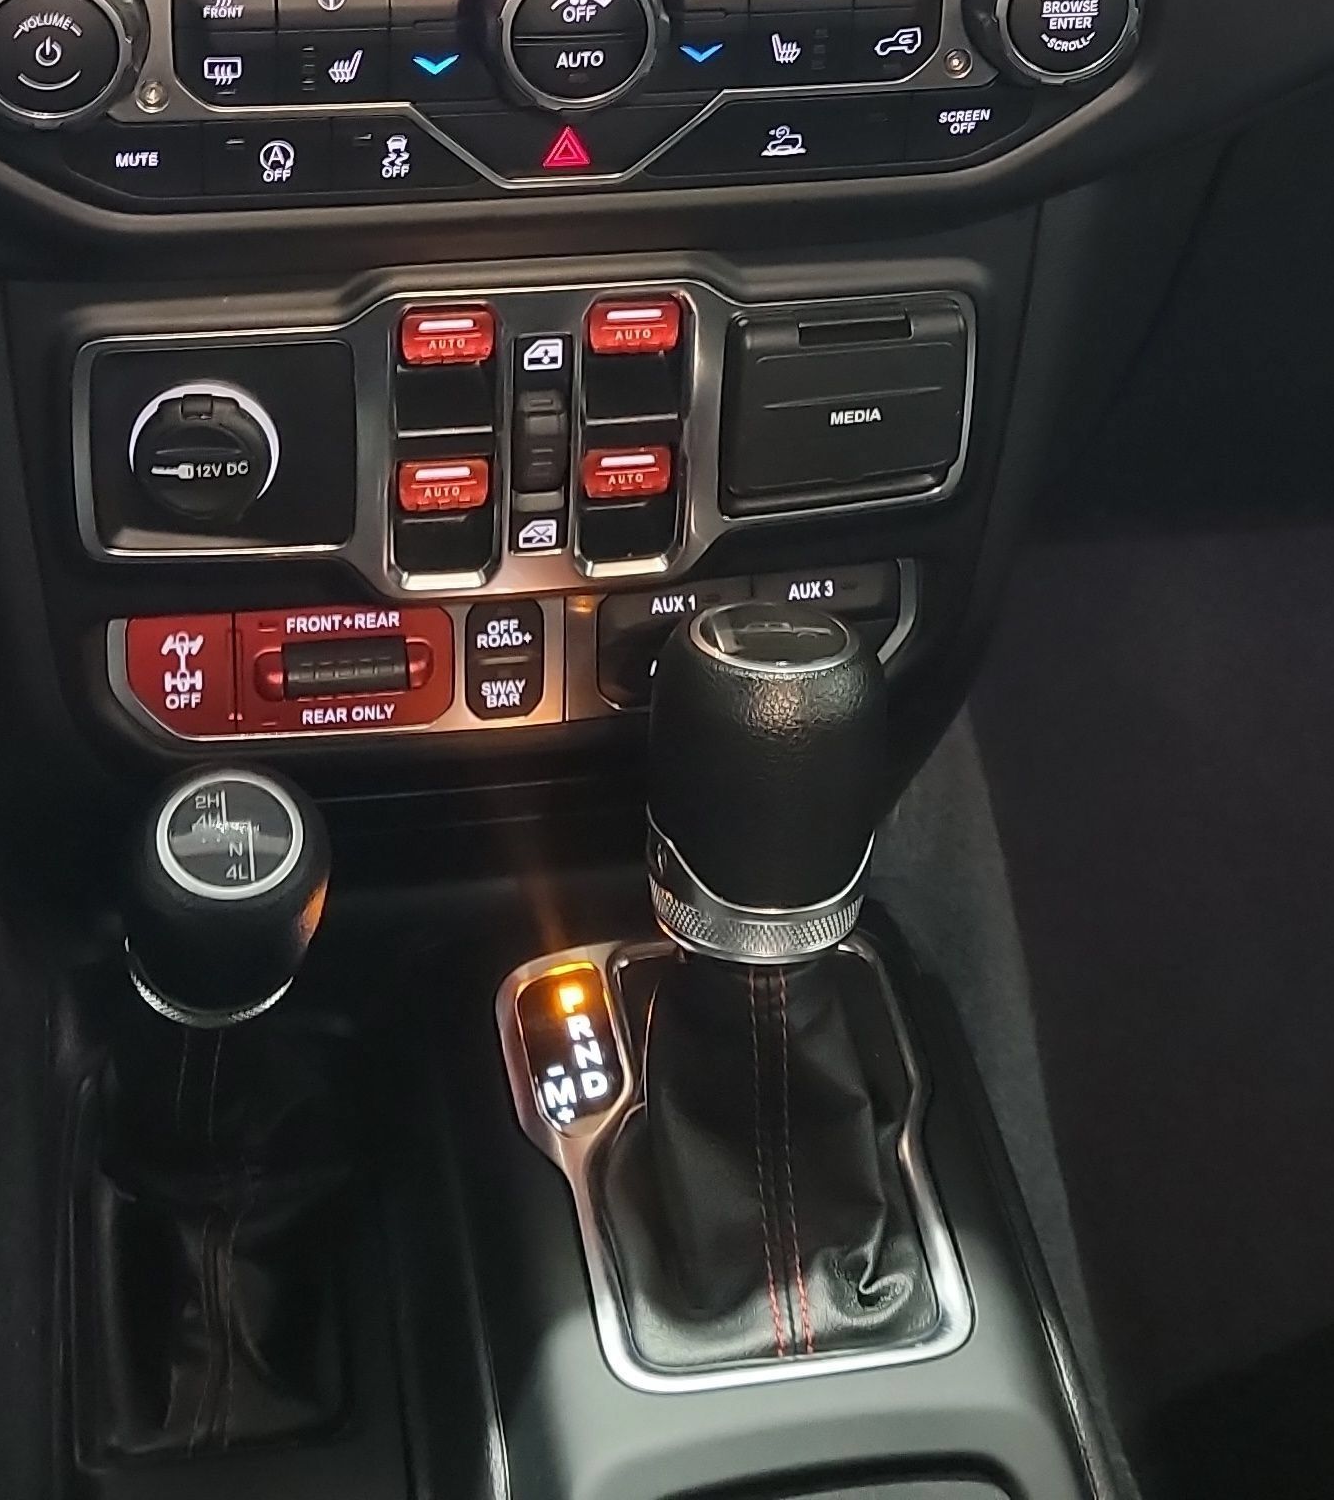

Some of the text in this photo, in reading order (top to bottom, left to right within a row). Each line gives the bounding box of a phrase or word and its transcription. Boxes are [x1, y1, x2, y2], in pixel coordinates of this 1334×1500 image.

[203, 5, 244, 19] FRONT
[562, 4, 597, 23] OFF
[1042, 0, 1099, 15] BROWSE
[20, 13, 72, 33] VOLUME
[1049, 16, 1093, 30] ENTER
[1046, 37, 1088, 52] SCROLL
[555, 50, 605, 69] AUTO
[938, 109, 992, 124] SCREEN
[949, 122, 977, 135] OFF
[115, 151, 159, 168] MUTE
[262, 168, 293, 183] OFF
[381, 164, 411, 179] OFF
[615, 329, 653, 341] AUTO
[428, 339, 467, 350] AUTO
[829, 407, 882, 427] MEDIA
[195, 461, 249, 479] 12V DC
[608, 473, 645, 486] AUTO
[423, 487, 461, 498] AUTO
[788, 579, 835, 601] AUX 3
[651, 595, 697, 615] AUX 1
[487, 619, 519, 634] OFF
[481, 679, 526, 697] SWAY
[165, 693, 202, 710] OFF
[486, 693, 521, 709] BAR
[301, 703, 396, 726] REAR ONLY
[195, 793, 220, 810] 2H
[229, 841, 243, 857] N
[225, 863, 249, 881] 4L
[559, 987, 585, 1013] P
[568, 1015, 594, 1040] R
[574, 1040, 604, 1069] N
[543, 1077, 578, 1109] M
[581, 1070, 609, 1099] D
